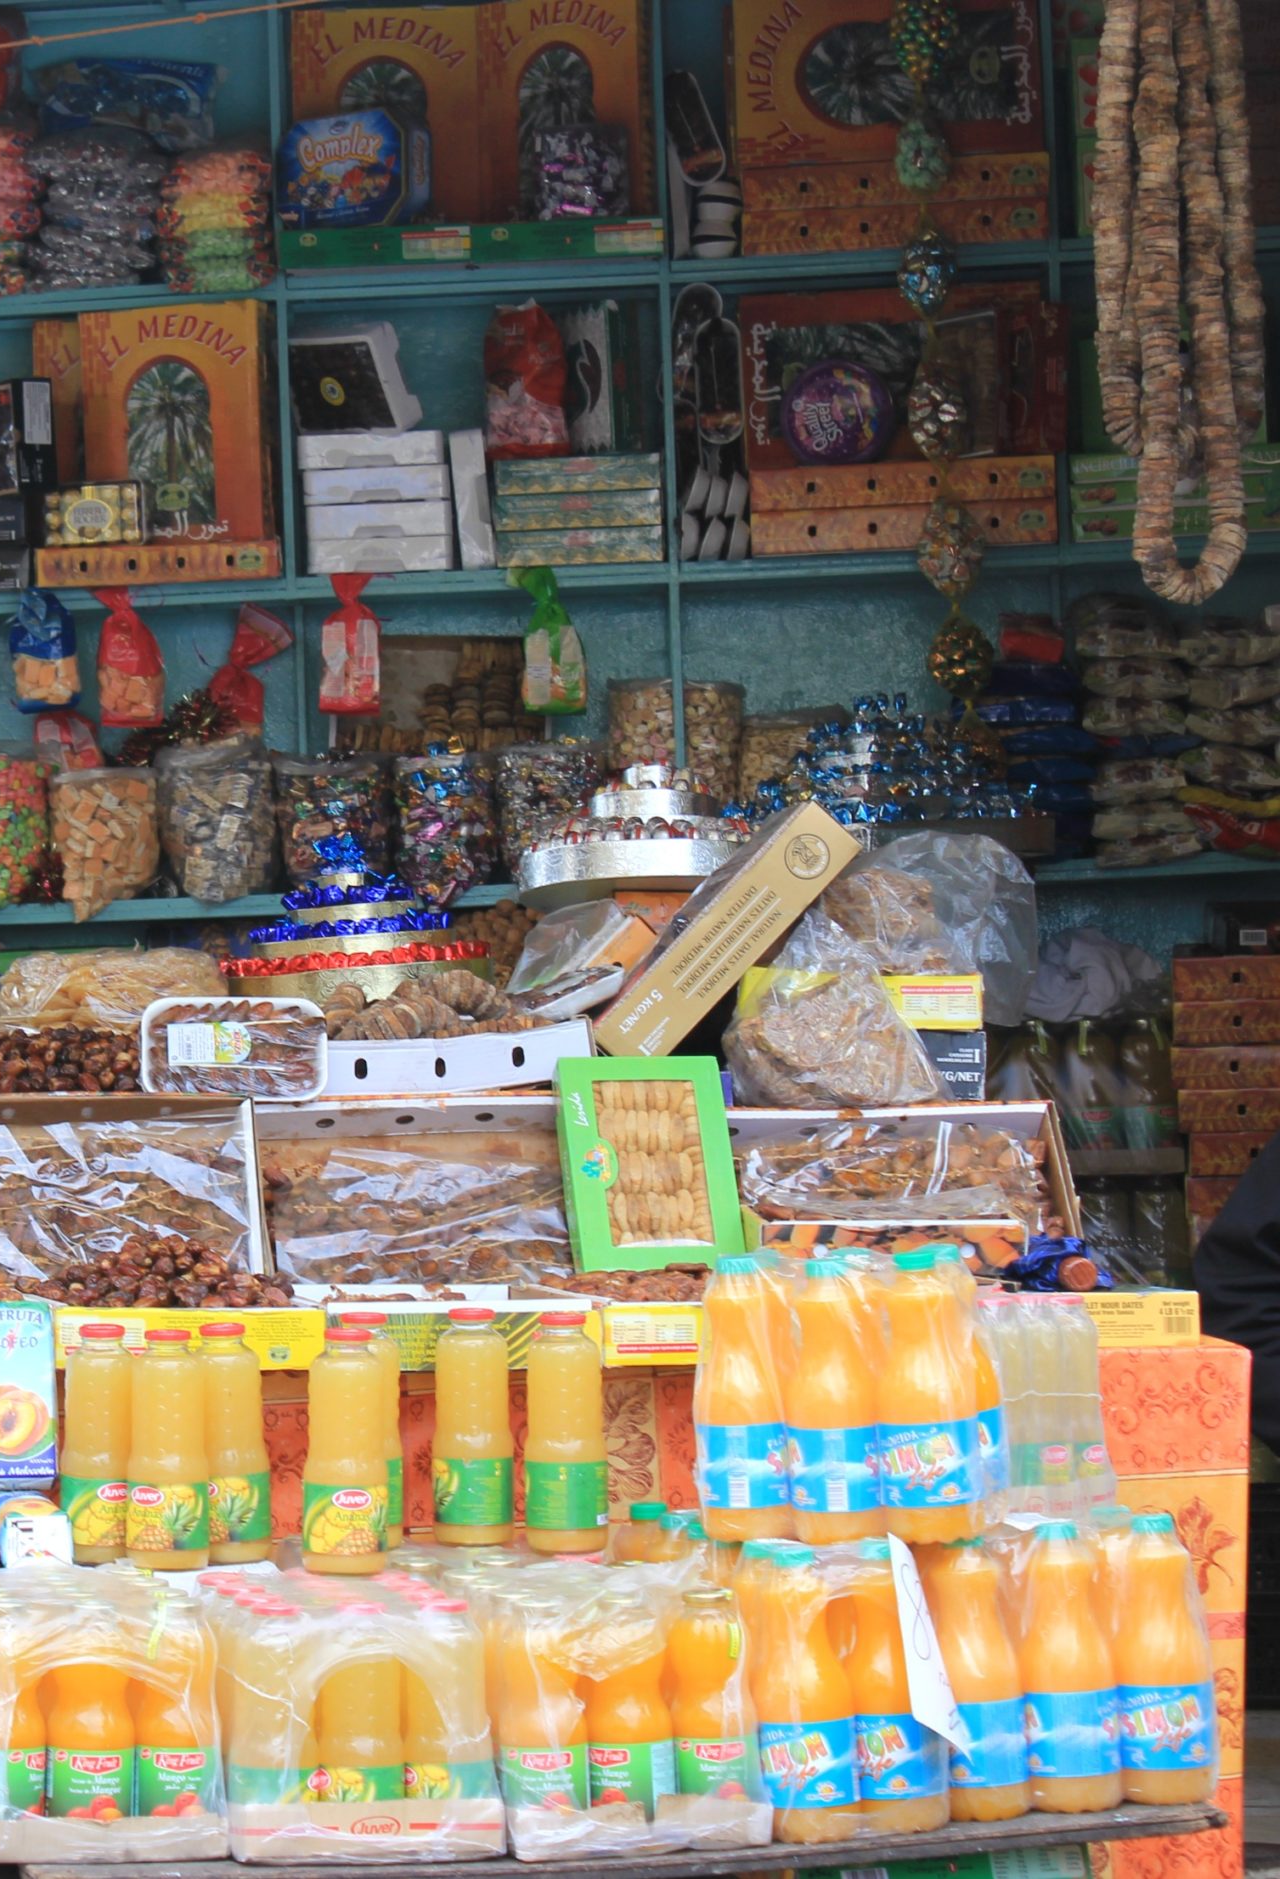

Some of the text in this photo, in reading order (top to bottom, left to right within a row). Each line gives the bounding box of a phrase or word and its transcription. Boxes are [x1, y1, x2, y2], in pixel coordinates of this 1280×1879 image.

[308, 17, 467, 70] EL MEDINA
[491, 0, 626, 60] EL MEDINA
[746, 0, 805, 153] EL MEDINA
[297, 122, 383, 172] Complex
[96, 313, 248, 372] EL MEDINA
[805, 403, 827, 451] Quality
[679, 890, 777, 994] DATTES NATURELLES MEDJOUL
[696, 909, 782, 999] NATURAL DATES MEDJOUL
[702, 919, 727, 946] NATUR
[670, 943, 704, 977] MEDJOUL
[619, 988, 663, 1035] 5 KG/NET
[132, 1489, 160, 1502] Juver
[337, 1494, 369, 1505] Juver
[1122, 1693, 1199, 1739] SIMON
[761, 1731, 828, 1773] IMON
[354, 1817, 396, 1837] Juver
